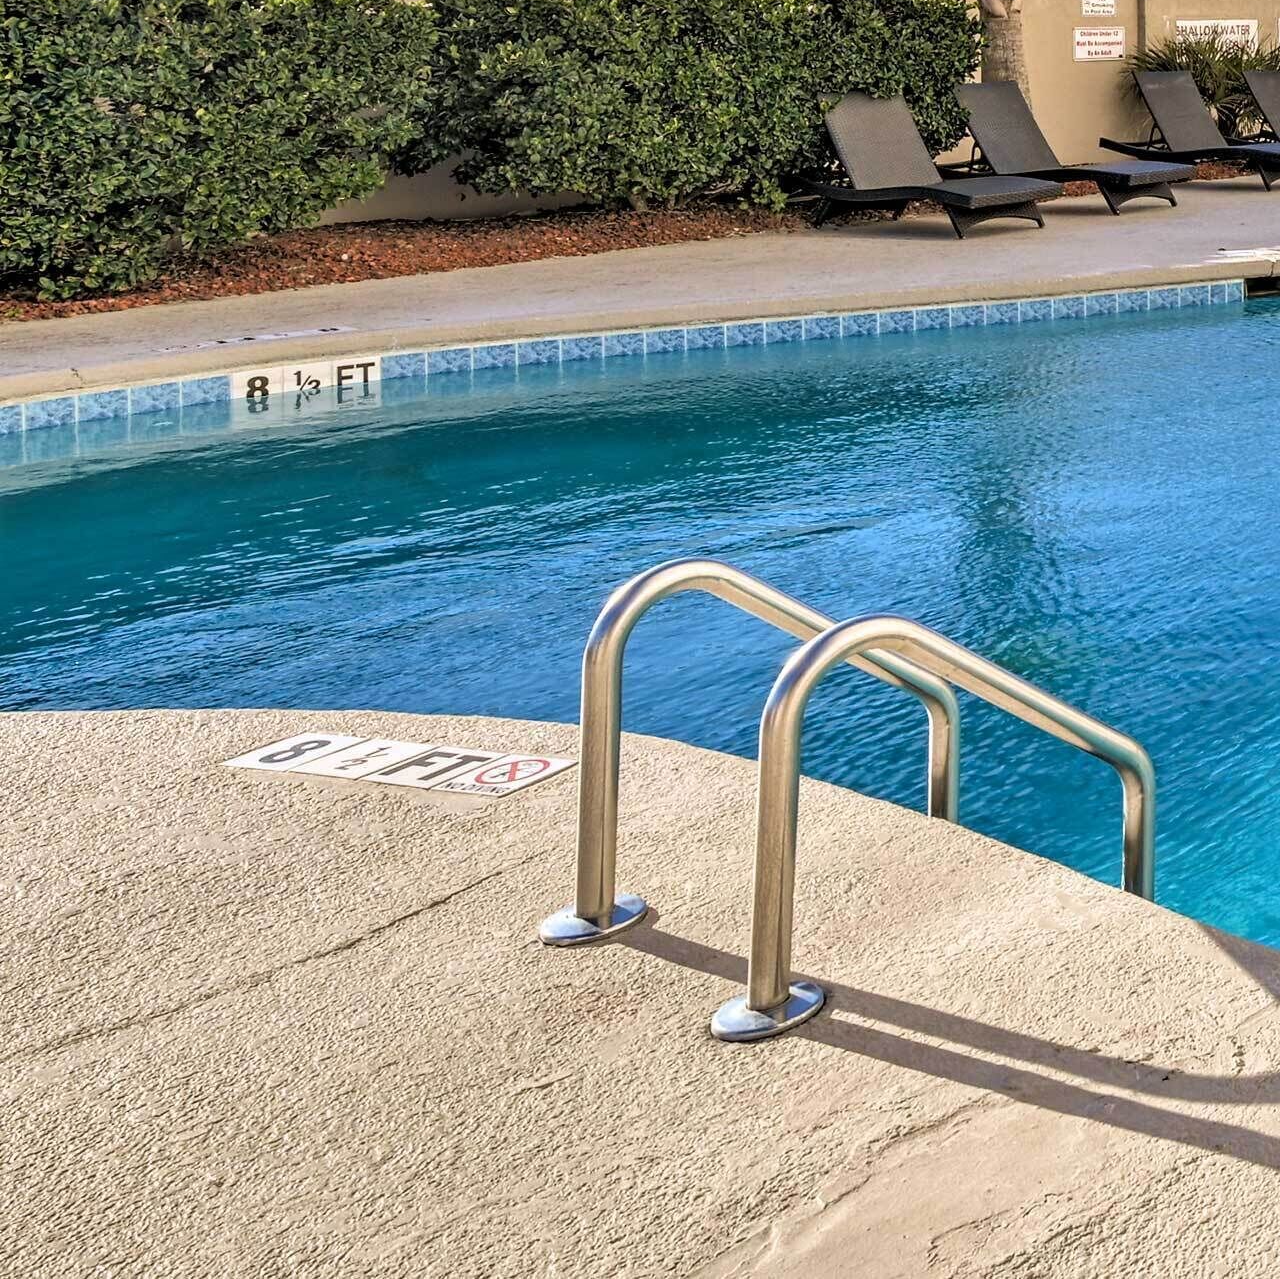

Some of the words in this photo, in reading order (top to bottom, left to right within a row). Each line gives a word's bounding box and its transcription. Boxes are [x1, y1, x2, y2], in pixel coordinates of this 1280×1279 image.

[1176, 24, 1219, 36] SHALLOW
[1220, 24, 1250, 35] WATER
[246, 375, 270, 399] 8
[336, 362, 375, 391] FT
[258, 739, 332, 763] 8
[378, 751, 493, 781] FT
